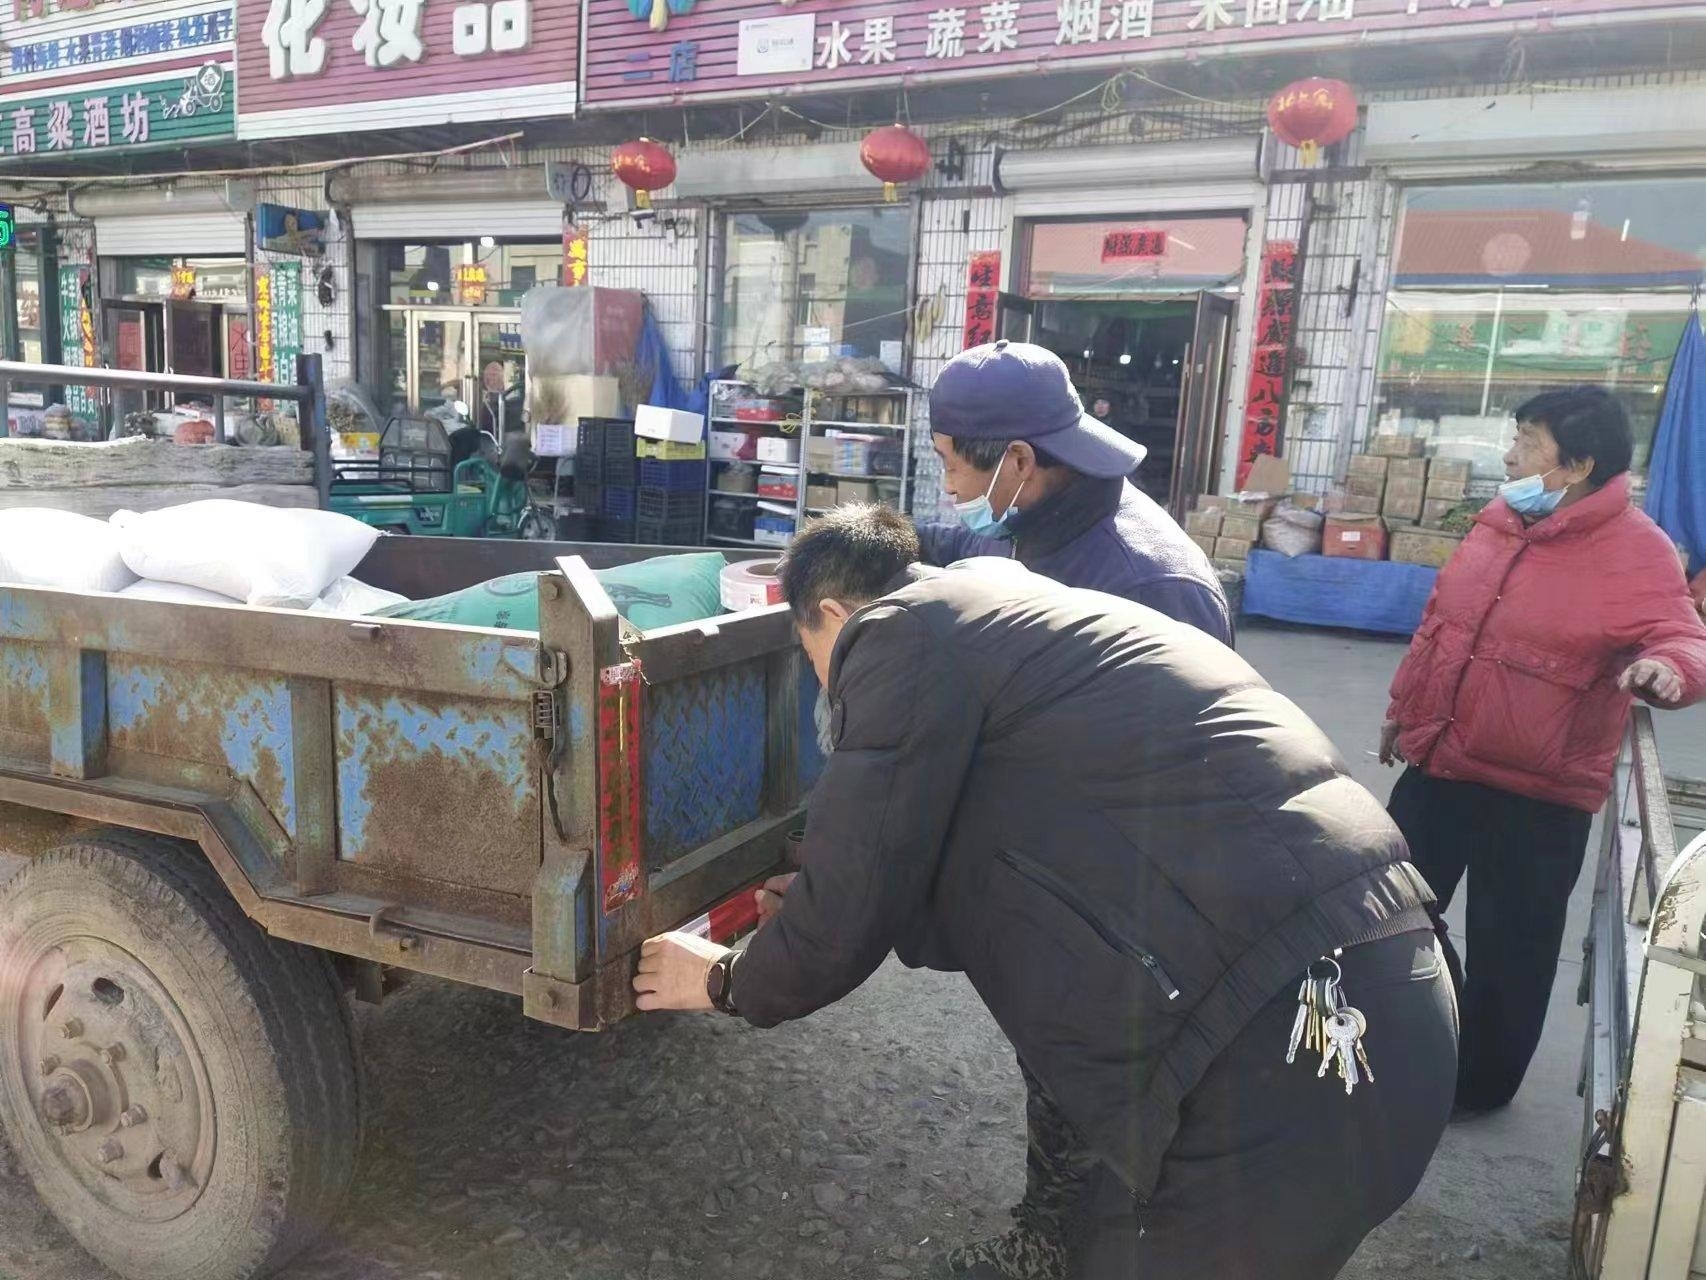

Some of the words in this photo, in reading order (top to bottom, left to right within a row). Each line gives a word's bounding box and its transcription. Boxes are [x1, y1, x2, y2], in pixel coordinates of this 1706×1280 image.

[261, 0, 528, 80] 化妆品
[623, 40, 699, 82] 二店
[817, 16, 897, 68] 水果
[926, 2, 1020, 58] 蔬菜
[1055, 0, 1151, 45] 烟酒
[0, 90, 149, 153] 高粱酒坊
